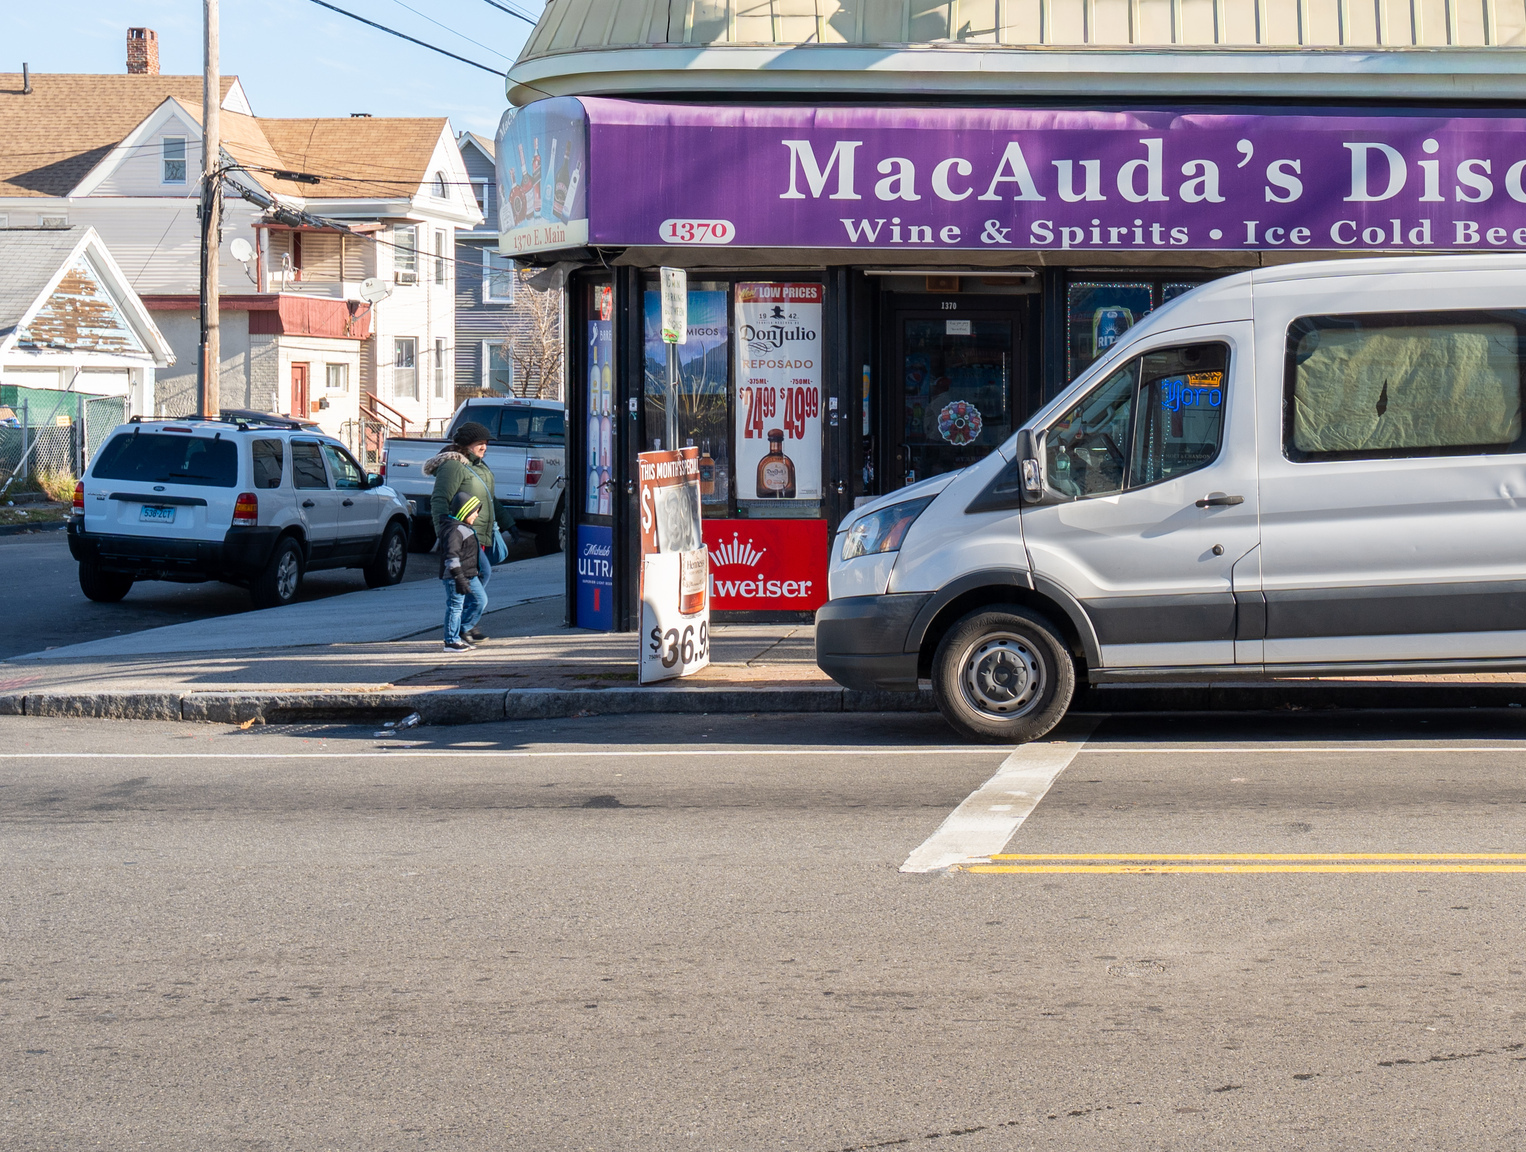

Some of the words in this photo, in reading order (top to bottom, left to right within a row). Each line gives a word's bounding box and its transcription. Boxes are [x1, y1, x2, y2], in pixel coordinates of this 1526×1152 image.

[779, 138, 1303, 203] MacAuda's
[514, 234, 532, 252] 1370
[534, 231, 543, 245] E.
[544, 225, 566, 244] Main
[668, 223, 728, 243] 1370
[839, 218, 961, 244] Wine
[980, 219, 1012, 244] &
[1030, 218, 1189, 249] Spirits
[1243, 220, 1311, 245] Ice
[1331, 219, 1435, 245] Cold
[759, 287, 780, 298] LOW
[782, 287, 817, 299] PRICES
[941, 301, 957, 310] 1370
[742, 359, 813, 369] REPOSADO
[1162, 379, 1222, 412] Coro
[640, 463, 655, 481] THIS
[583, 543, 611, 556] Michelob
[709, 573, 812, 598] weiser
[649, 620, 709, 668] $36.9
